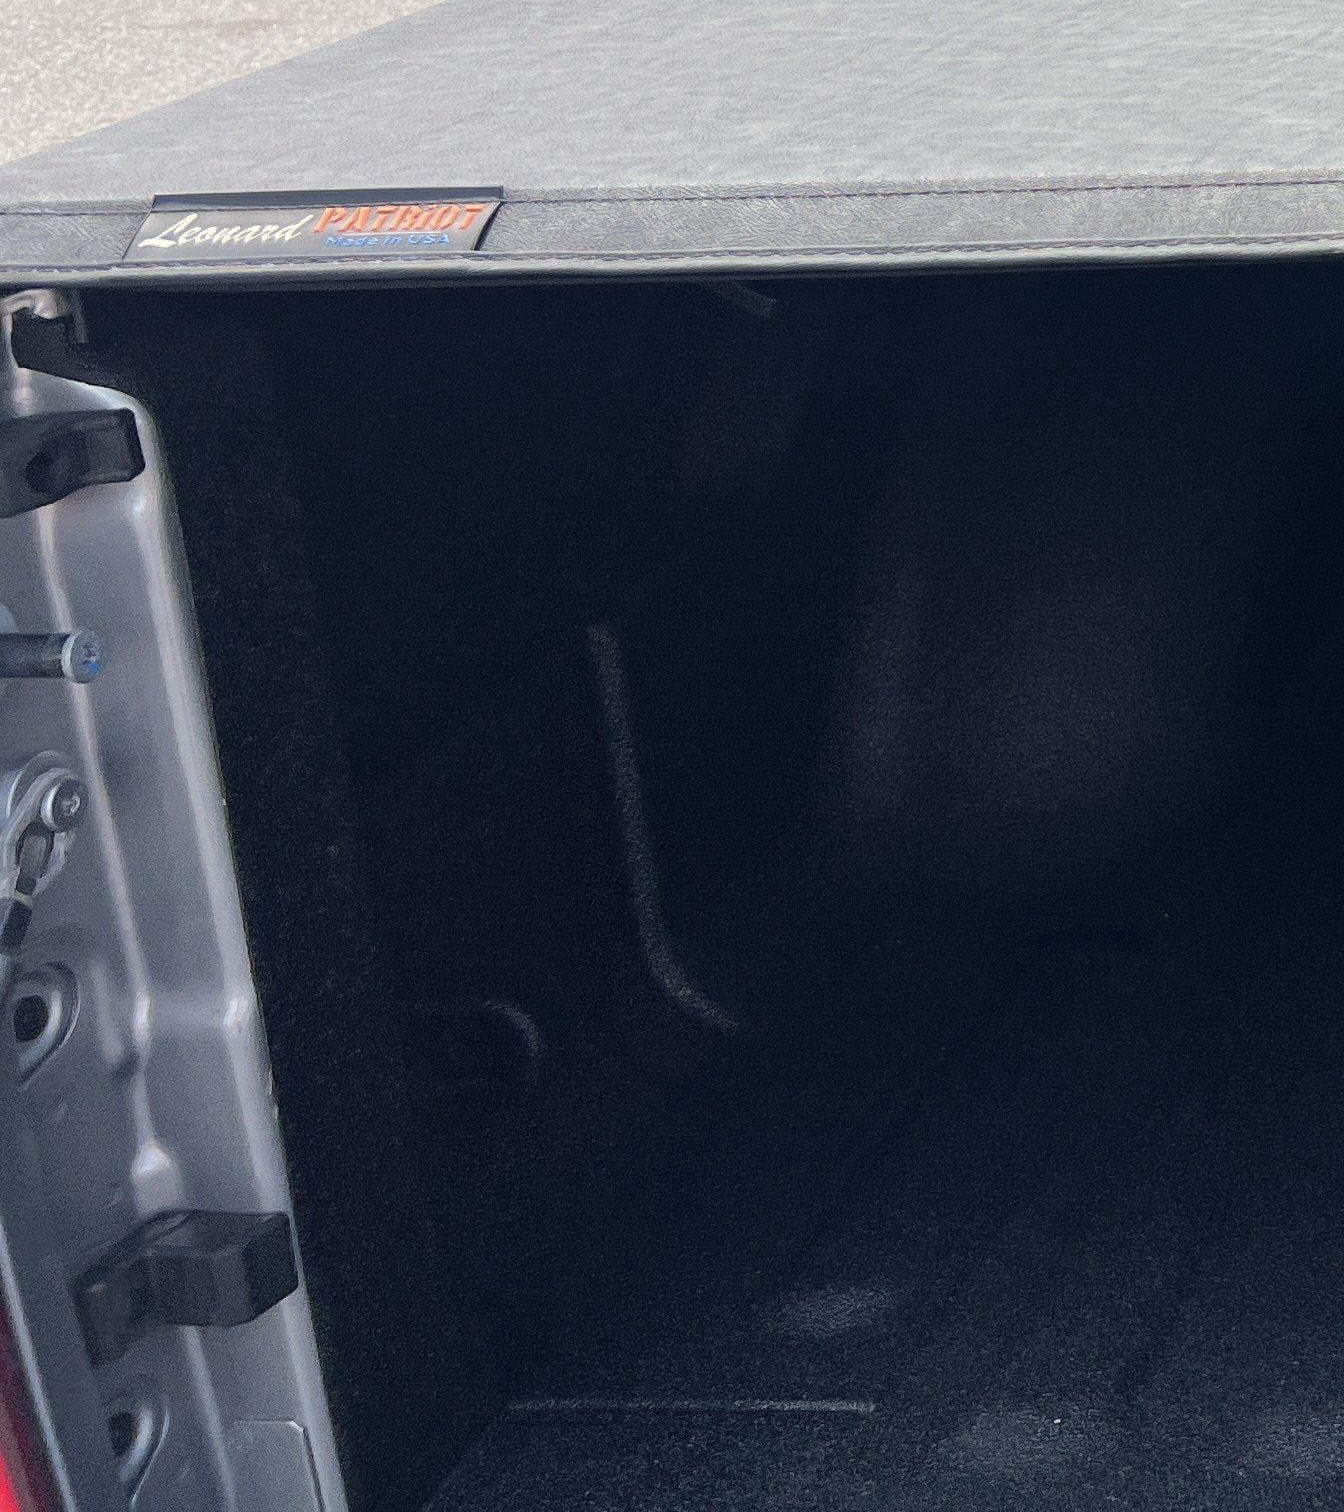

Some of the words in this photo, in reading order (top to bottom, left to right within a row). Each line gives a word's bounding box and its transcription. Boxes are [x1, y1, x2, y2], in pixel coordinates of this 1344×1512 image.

[137, 213, 314, 249] Leonard
[325, 236, 378, 248] Made
[407, 233, 450, 245] USA
